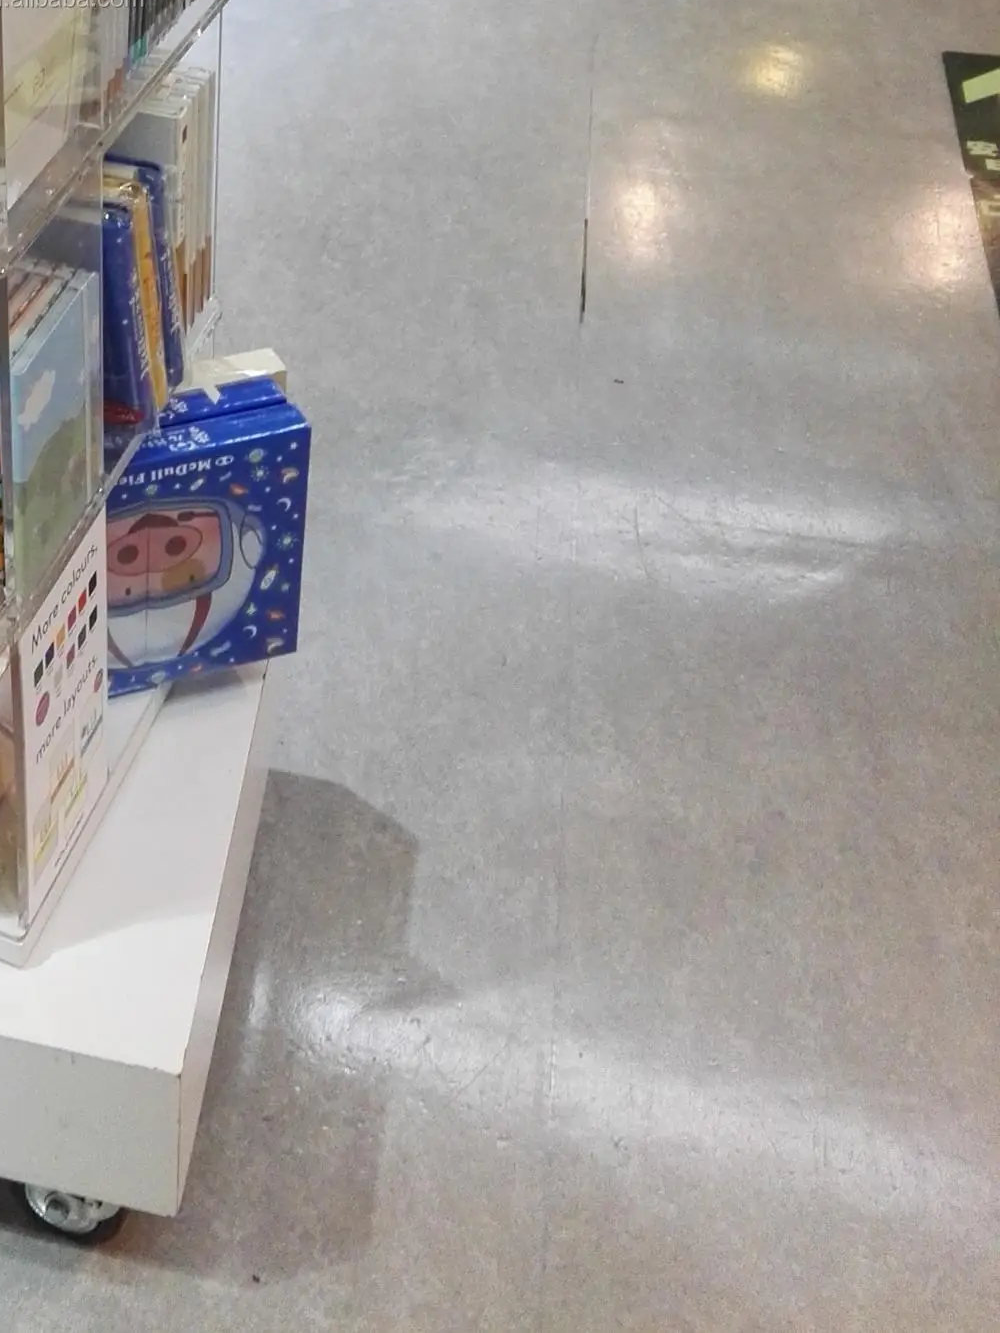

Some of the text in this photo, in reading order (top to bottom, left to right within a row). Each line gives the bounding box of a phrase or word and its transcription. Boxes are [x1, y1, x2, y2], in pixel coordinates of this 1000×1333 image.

[150, 457, 211, 479] McDull
[31, 598, 60, 654] More
[35, 718, 63, 766] more
